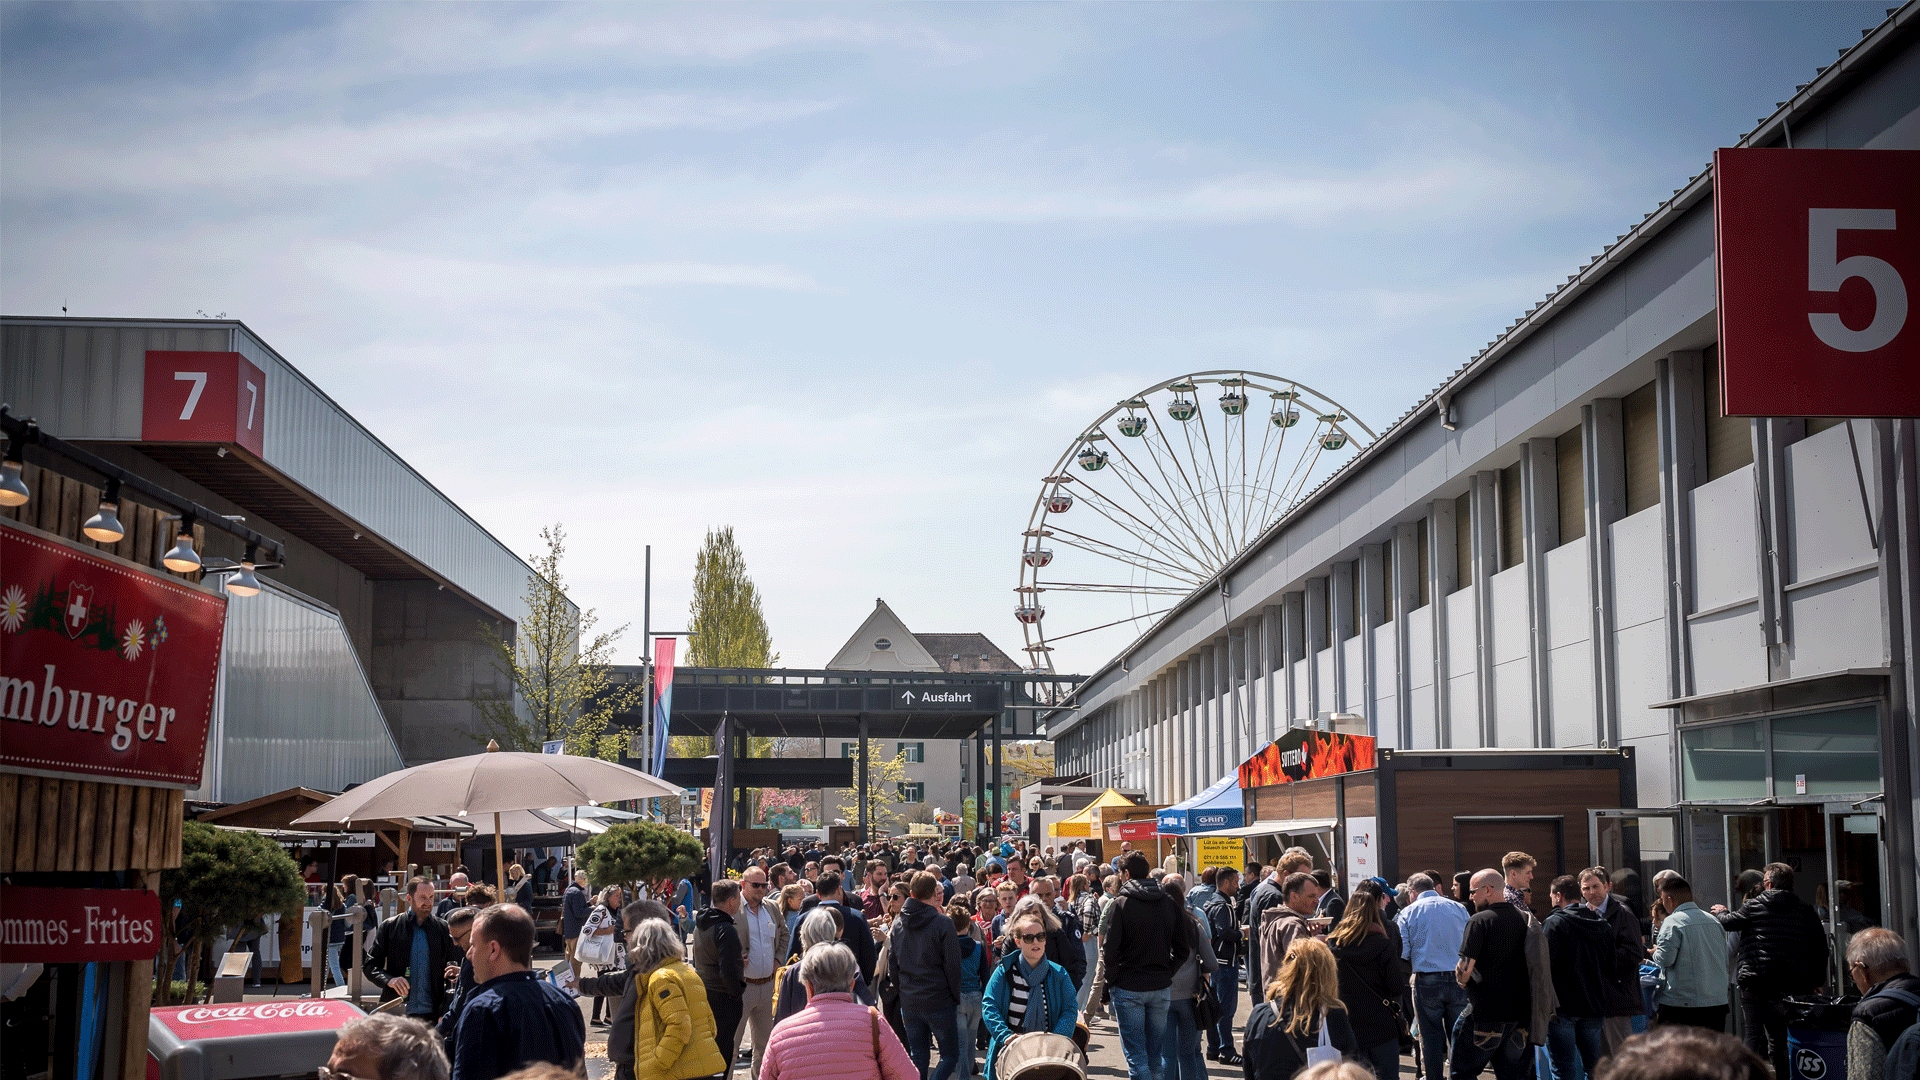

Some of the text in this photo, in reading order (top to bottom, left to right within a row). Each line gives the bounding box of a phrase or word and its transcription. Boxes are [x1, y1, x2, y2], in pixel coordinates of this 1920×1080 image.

[1808, 207, 1908, 353] 5
[174, 371, 207, 420] 7
[246, 380, 257, 430] 7
[0, 664, 176, 751] mburger
[921, 691, 972, 703] Ausfahrt
[0, 906, 154, 946] mmes-Frites
